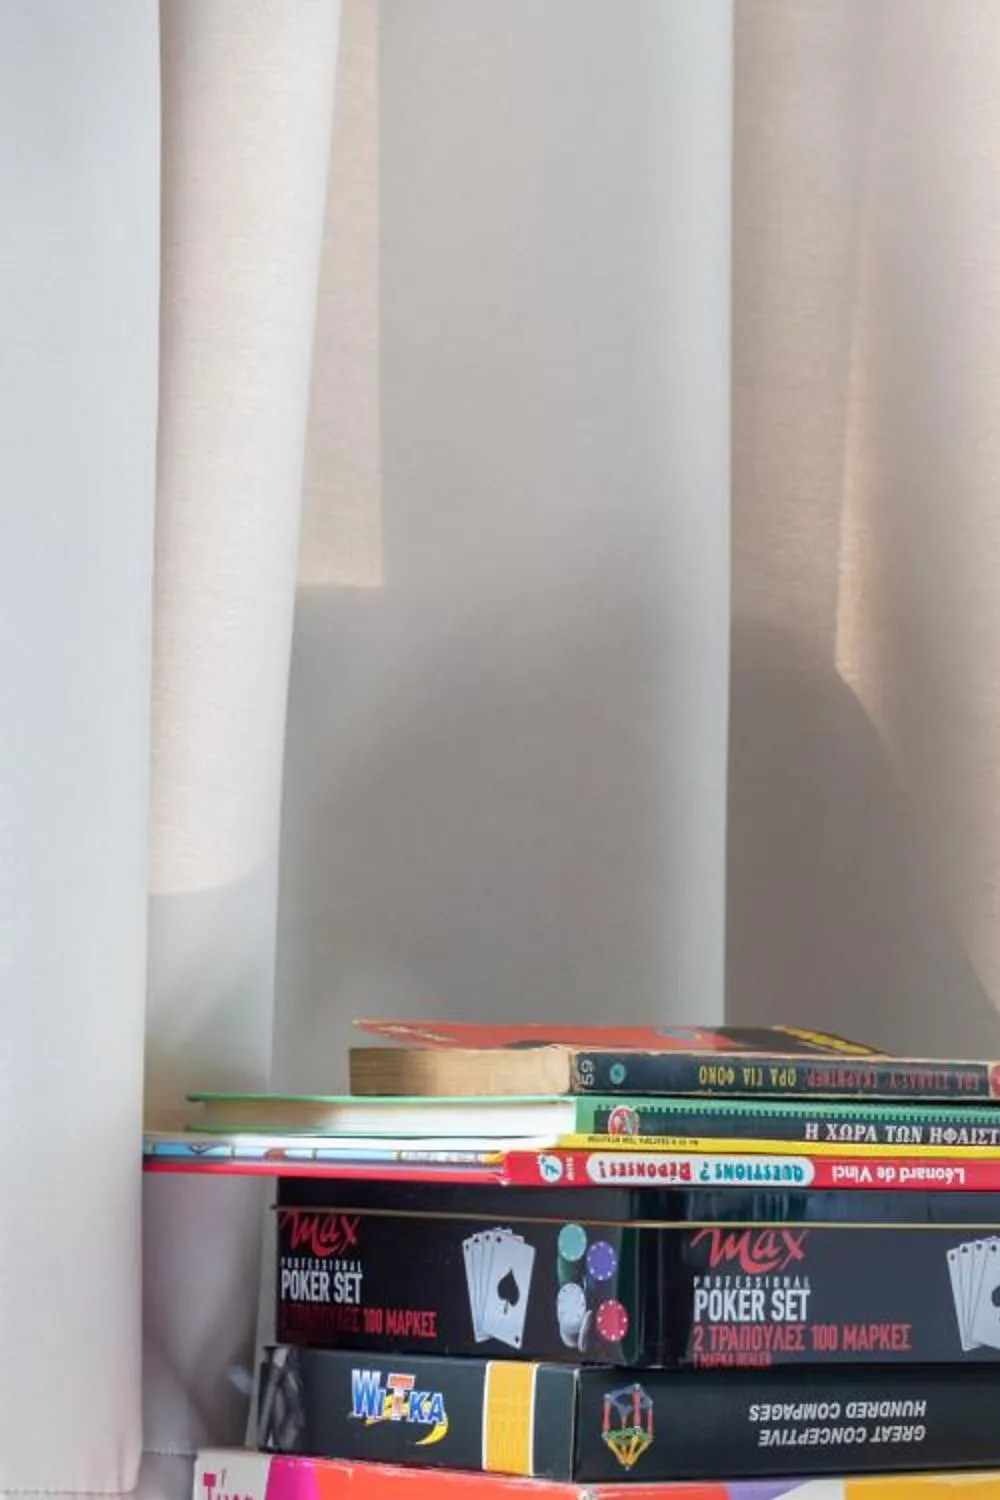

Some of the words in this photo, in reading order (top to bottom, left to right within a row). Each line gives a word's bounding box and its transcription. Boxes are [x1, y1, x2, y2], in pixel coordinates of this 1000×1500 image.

[699, 1065, 735, 1086] ΦΟΝΟ
[743, 1066, 763, 1087] ΓΙΑ
[769, 1066, 796, 1087] ΩΡΑ
[825, 1123, 878, 1143] ΧΩΡΑ
[886, 1125, 924, 1144] ΤΩΝ
[831, 1165, 873, 1184] Vinci
[876, 1166, 896, 1183] de
[900, 1166, 965, 1185] Léonard
[281, 1269, 331, 1302] POKER
[333, 1272, 363, 1305] SET
[693, 1275, 811, 1289] PROFESSIONAL
[693, 1289, 766, 1323] POKER
[771, 1289, 811, 1323] SET
[386, 1309, 438, 1339] ΜΑΡΚΕΣ
[693, 1324, 705, 1351] 2
[709, 1324, 806, 1351] ΤΡΑΠΟΥΛΕΣ
[810, 1324, 838, 1351] 100
[842, 1323, 913, 1352] ΜΑΡΚΕΣ
[749, 1403, 841, 1422] COMPAGES
[845, 1400, 927, 1419] HUNDRED
[757, 1427, 867, 1447] CONCEPTIVE
[870, 1425, 926, 1443] GREAT
